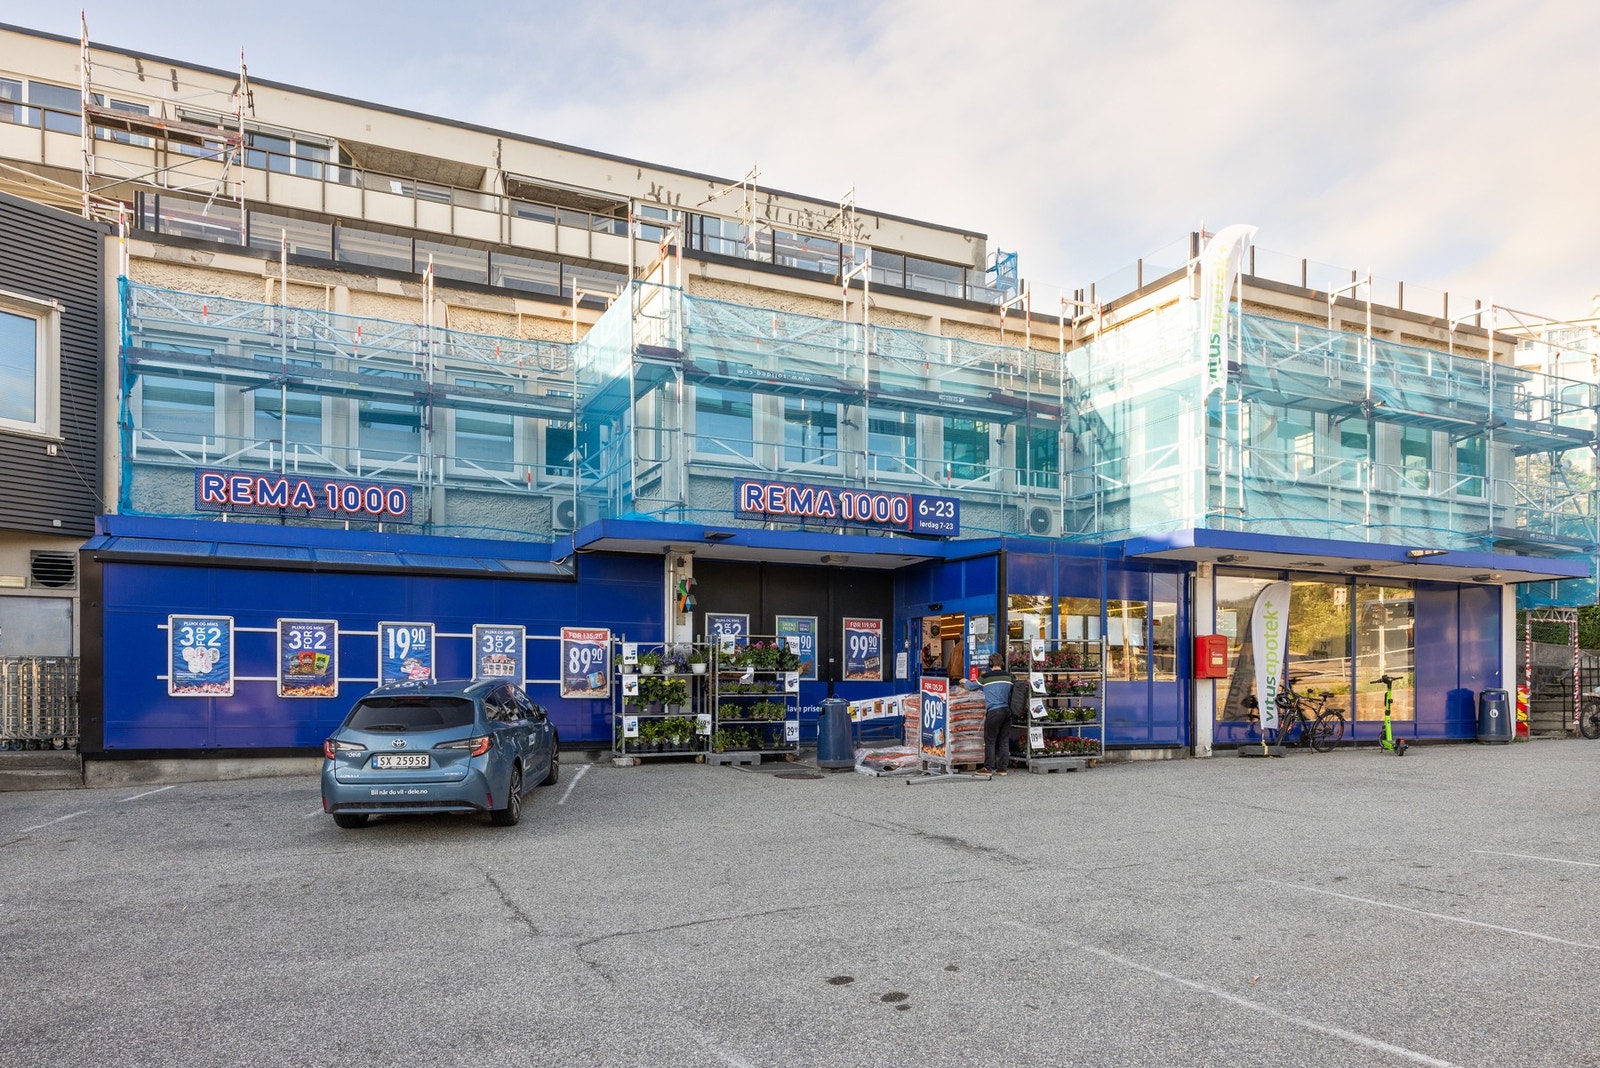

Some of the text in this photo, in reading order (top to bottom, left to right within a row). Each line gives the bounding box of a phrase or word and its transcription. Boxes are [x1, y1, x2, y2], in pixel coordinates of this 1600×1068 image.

[202, 473, 407, 515] REMA 1000
[741, 482, 909, 524] REMA 1000
[919, 499, 955, 518] 6-23
[919, 520, 954, 531] lørdag 7-23
[180, 626, 221, 647] 3 FOR 2
[724, 623, 732, 635] OR
[288, 630, 327, 650] 3 FOR 2
[482, 635, 516, 653] 3 FOR 2
[801, 635, 812, 649] 90
[380, 756, 427, 766] SX 25958
[407, 788, 428, 796] dele.no
